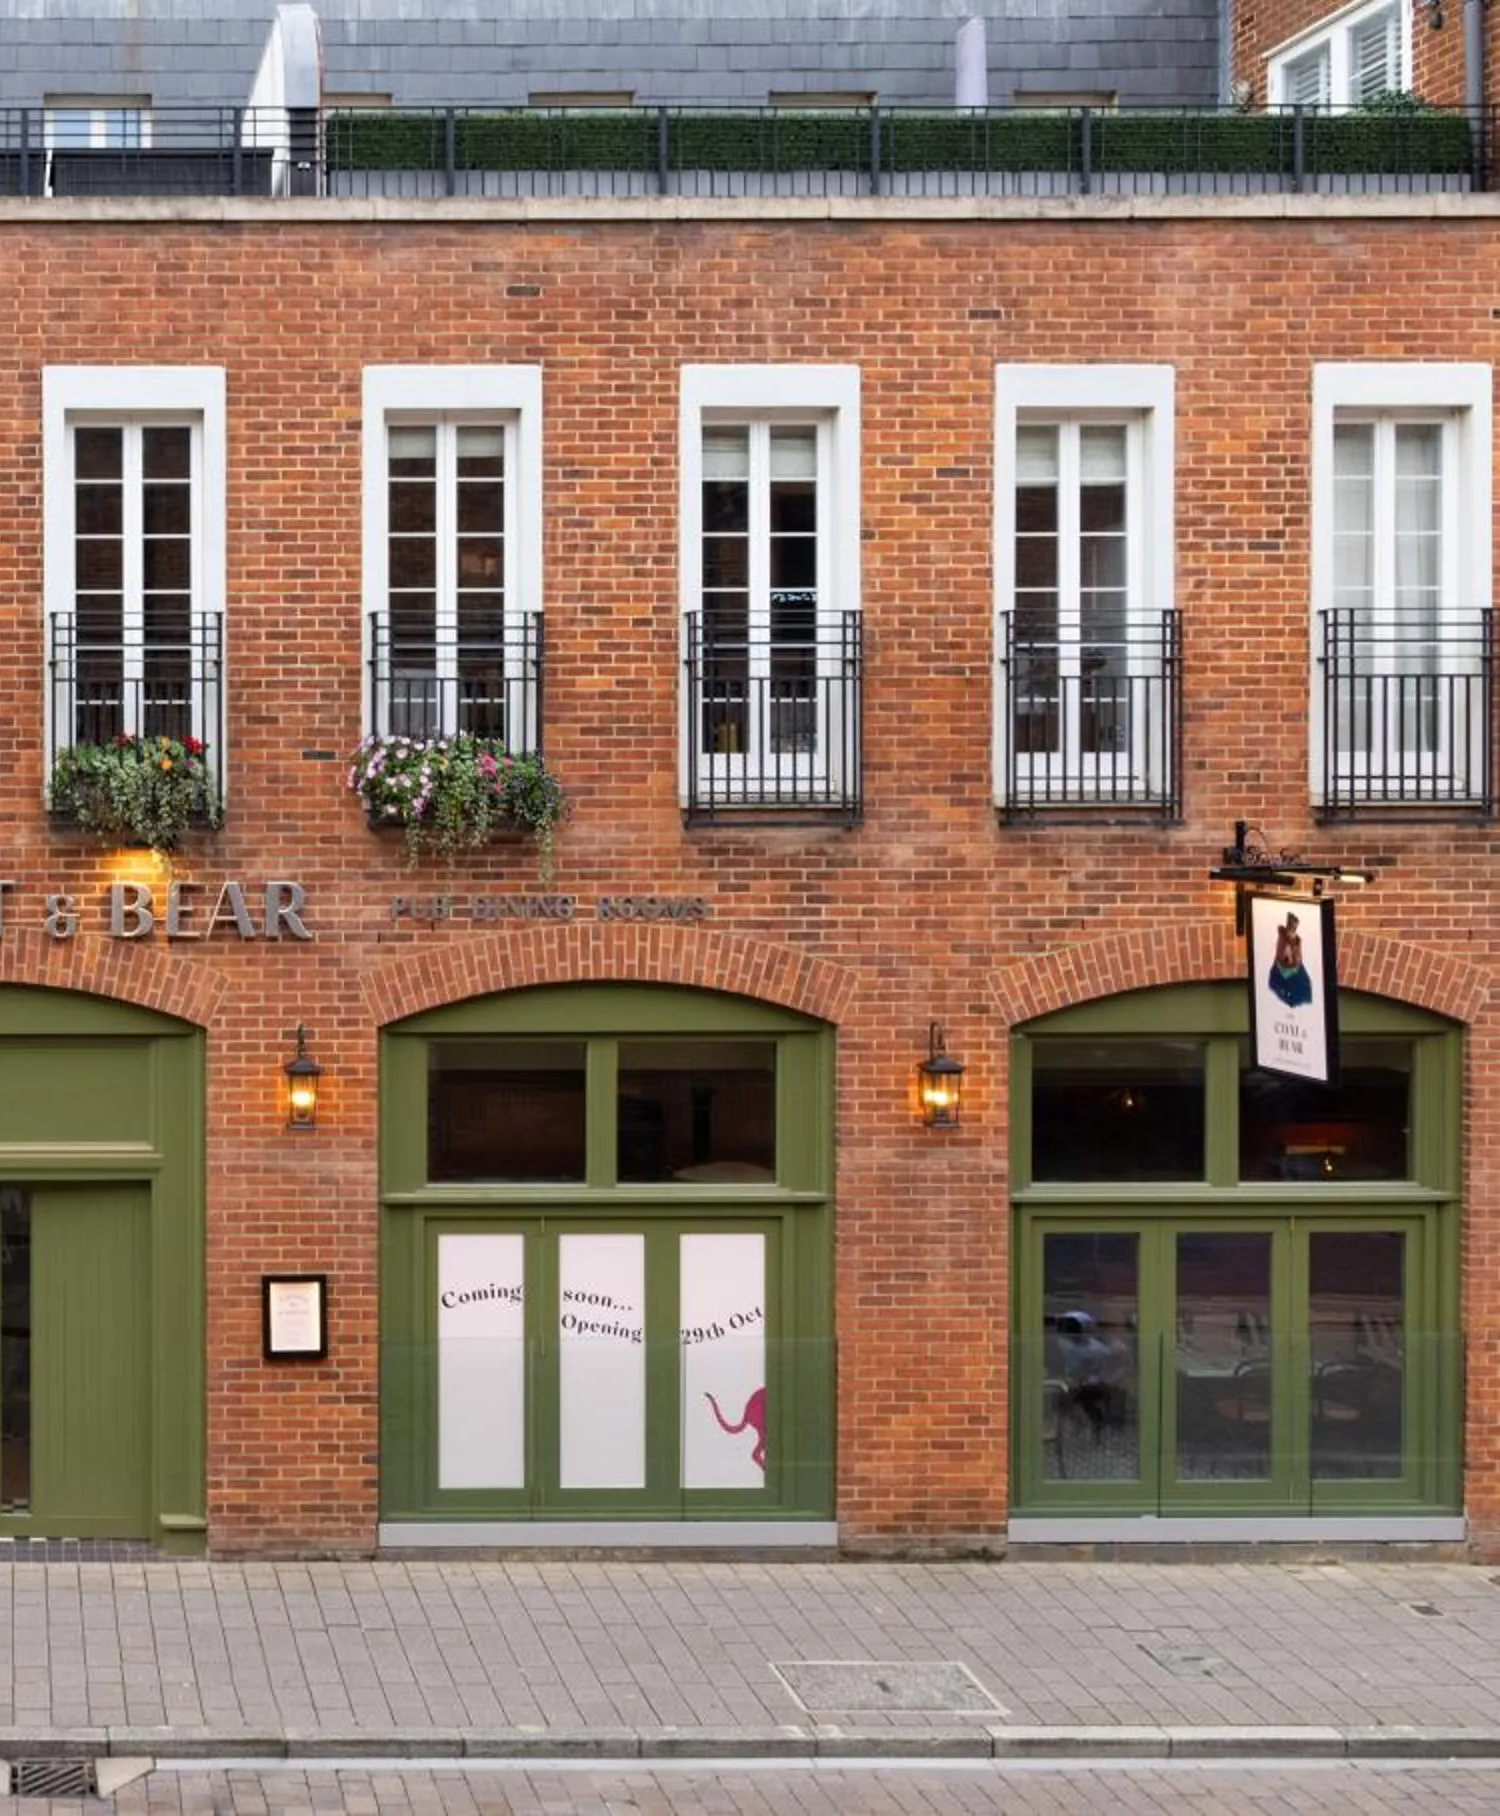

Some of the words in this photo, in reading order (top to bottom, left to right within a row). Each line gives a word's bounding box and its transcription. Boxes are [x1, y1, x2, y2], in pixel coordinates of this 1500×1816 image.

[43, 894, 80, 938] &
[109, 880, 314, 940] BEAR
[392, 896, 448, 920] PUB
[471, 896, 573, 920] DINING
[597, 896, 712, 920] ROOMS
[441, 1283, 522, 1309] Coming
[563, 1289, 633, 1311] soon...
[561, 1313, 642, 1344] Opening
[680, 1322, 725, 1345] 29th
[729, 1305, 763, 1330] Oct
